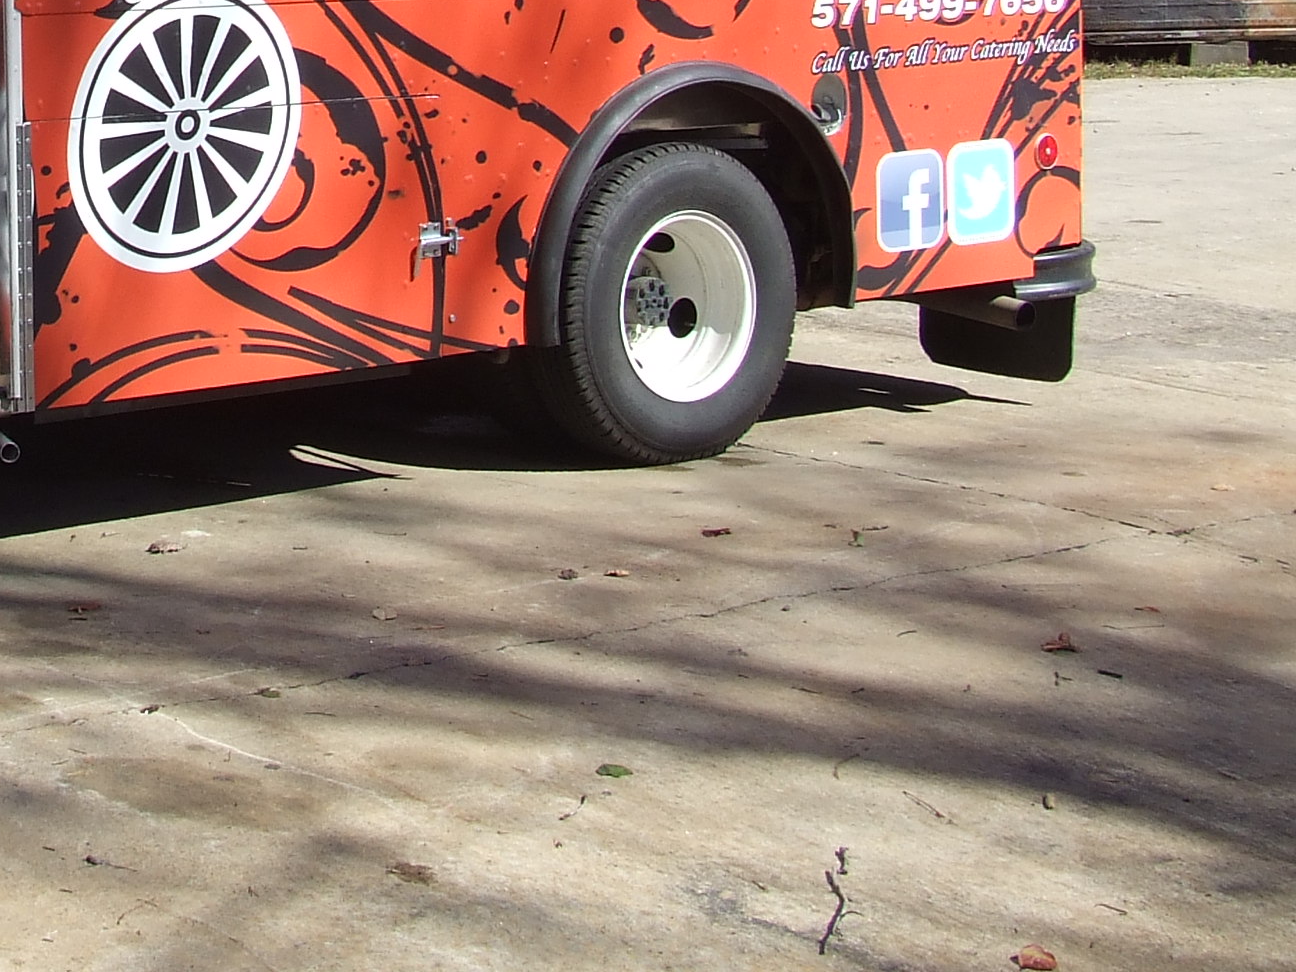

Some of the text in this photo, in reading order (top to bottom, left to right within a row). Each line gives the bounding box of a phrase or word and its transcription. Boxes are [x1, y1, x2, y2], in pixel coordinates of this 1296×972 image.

[811, 28, 1077, 74] Call Us For All Your Catering Needs
